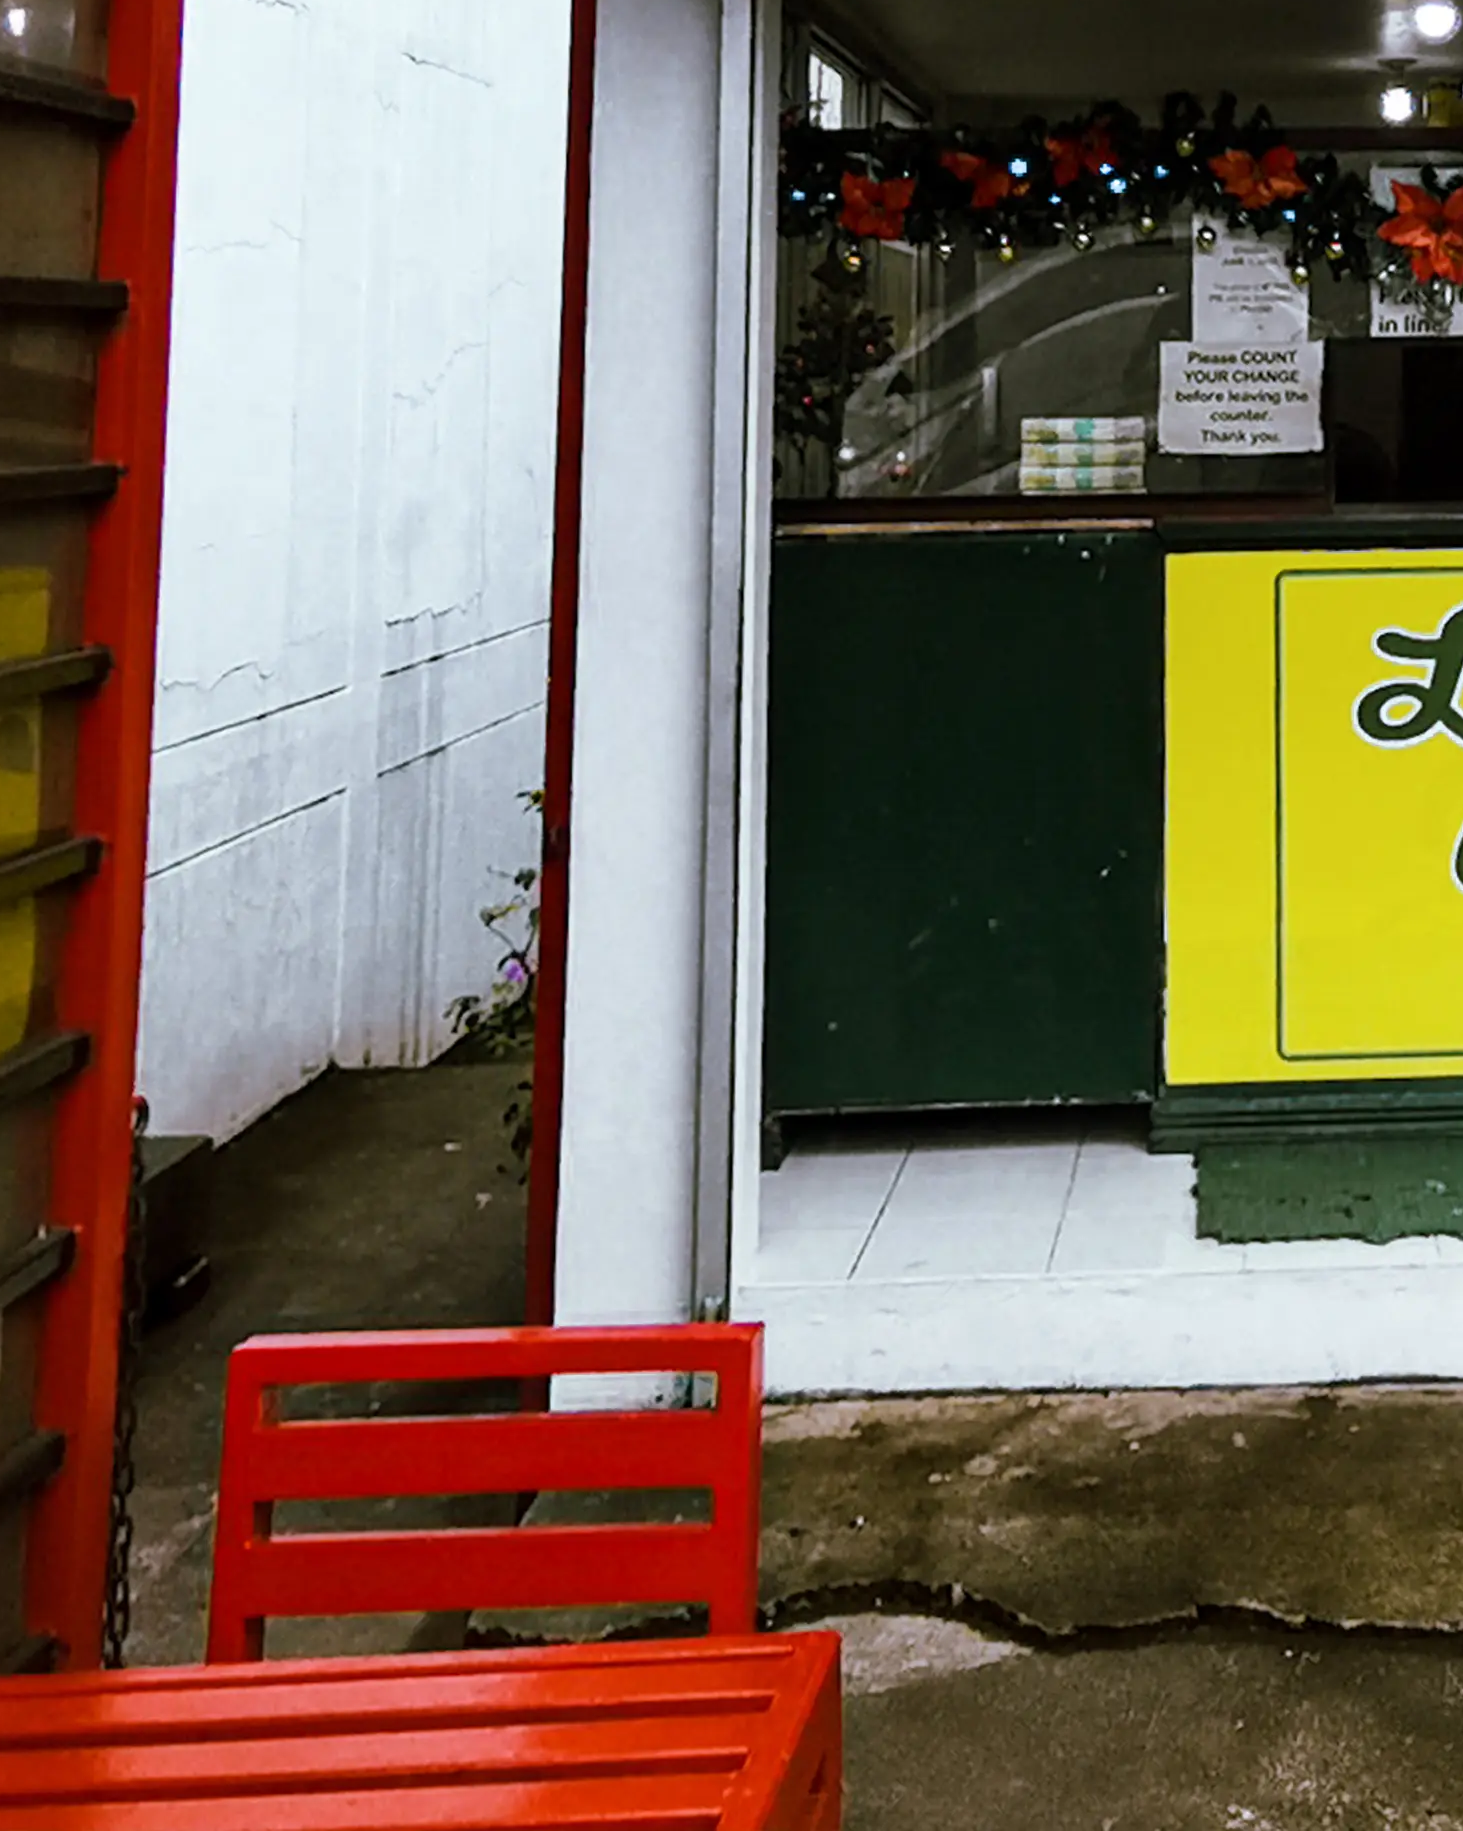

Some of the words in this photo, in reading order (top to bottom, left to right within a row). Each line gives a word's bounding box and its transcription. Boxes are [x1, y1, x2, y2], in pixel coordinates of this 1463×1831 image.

[1378, 315, 1399, 333] in
[1187, 350, 1237, 365] Please
[1240, 350, 1297, 365] COUNT
[1183, 370, 1229, 384] YOUR
[1232, 370, 1300, 384] CHANGE
[1175, 389, 1224, 403] before
[1227, 389, 1280, 407] leaving
[1285, 390, 1309, 404] the
[1201, 429, 1247, 443] Thank
